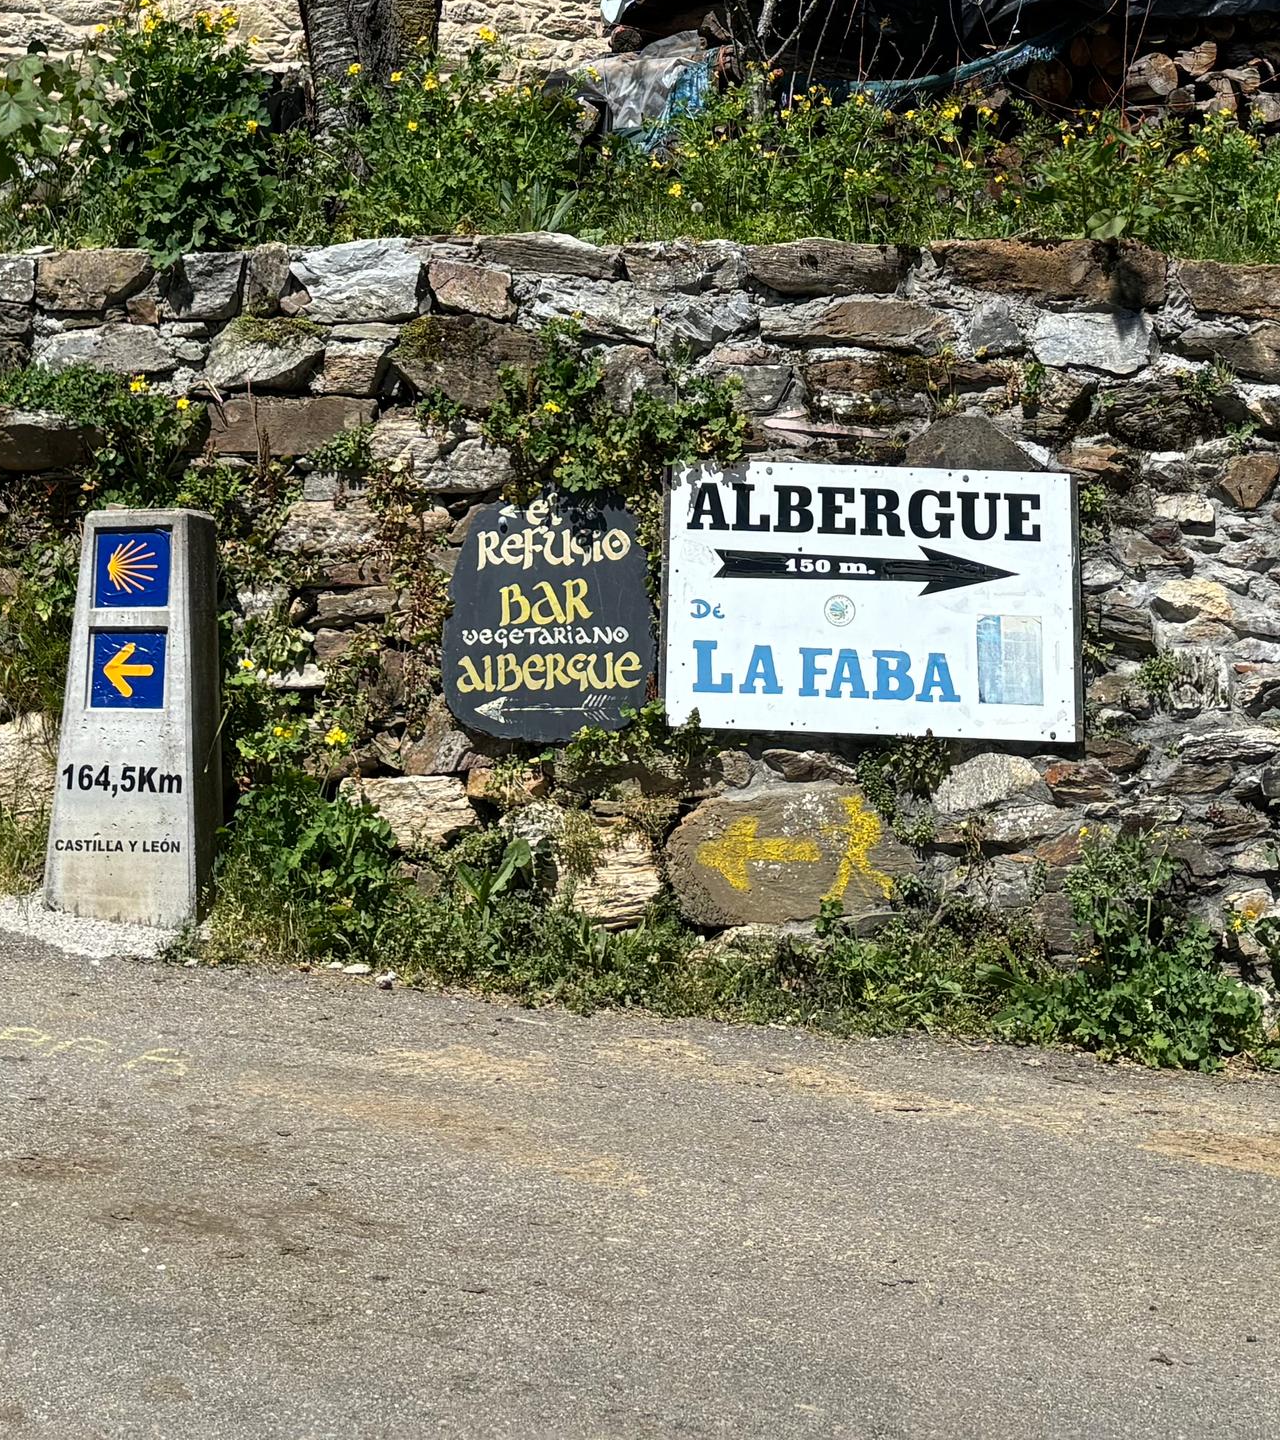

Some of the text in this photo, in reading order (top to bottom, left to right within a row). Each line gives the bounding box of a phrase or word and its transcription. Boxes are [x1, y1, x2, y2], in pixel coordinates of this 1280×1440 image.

[687, 482, 1042, 542] ALBERGUE
[784, 558, 876, 575] 150 m.
[692, 640, 783, 695] LA
[798, 647, 961, 703] FABA
[62, 763, 183, 798] 164,5Km
[55, 838, 181, 853] CASTILLA Y LEÓN
